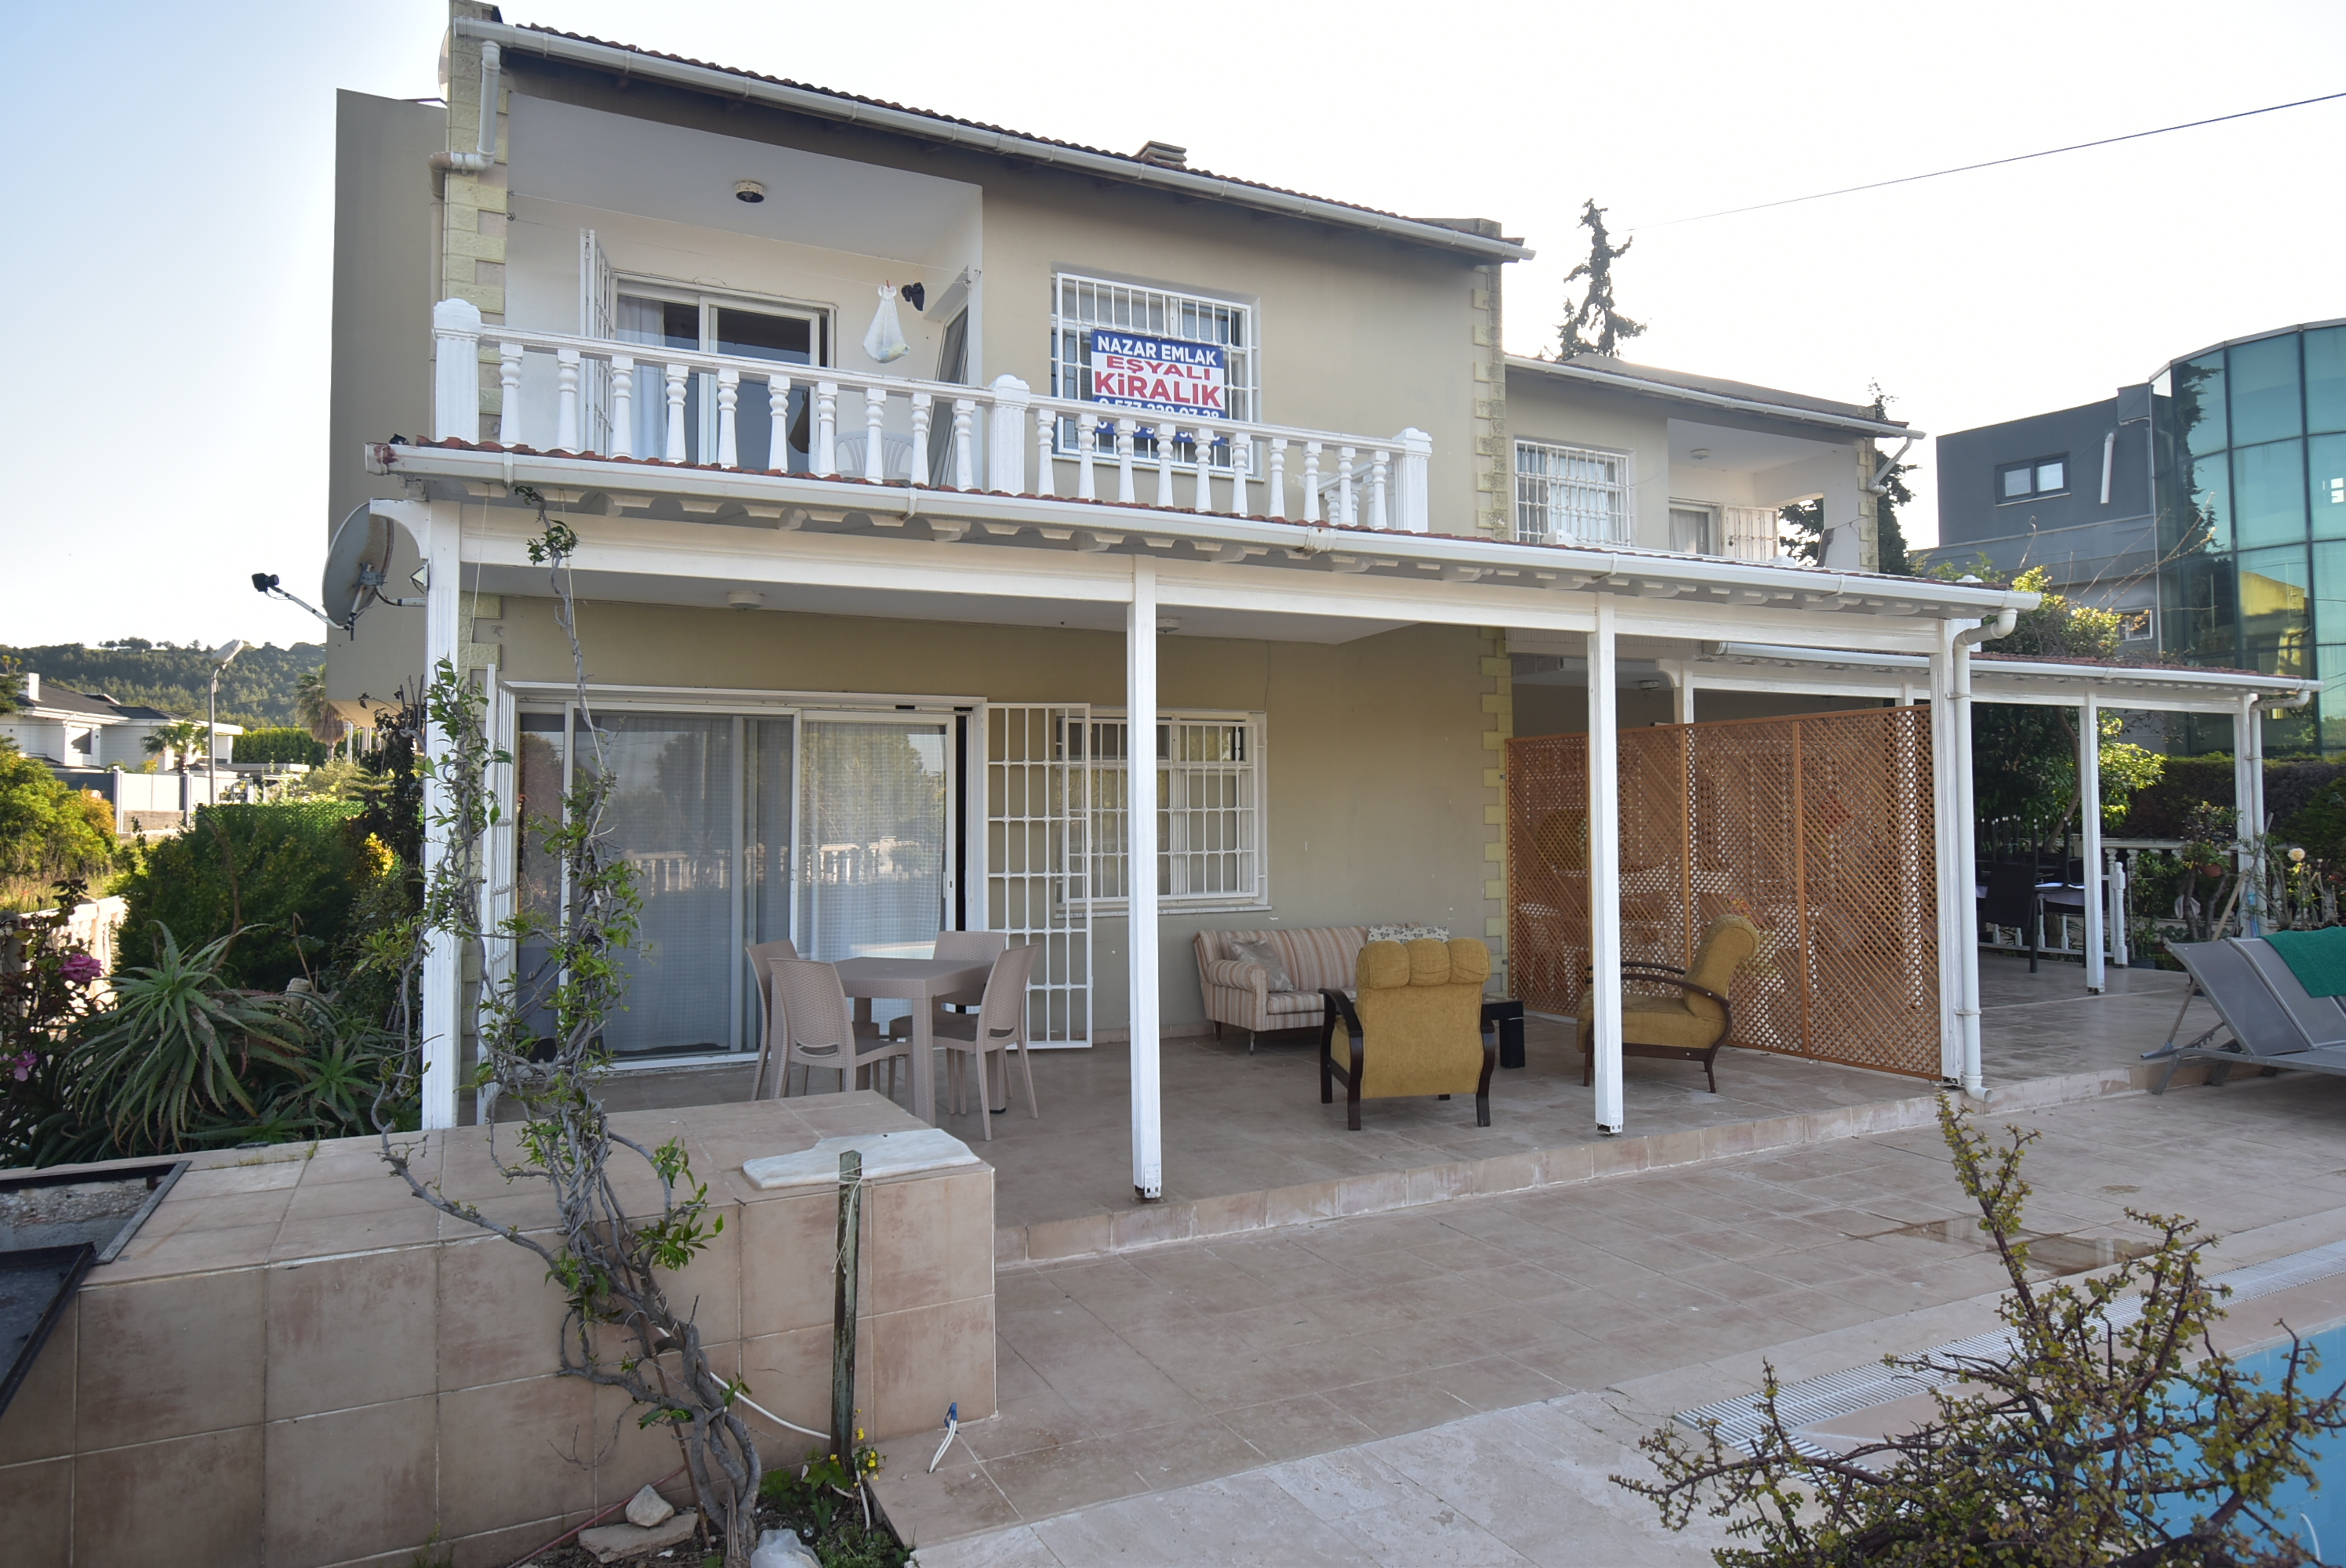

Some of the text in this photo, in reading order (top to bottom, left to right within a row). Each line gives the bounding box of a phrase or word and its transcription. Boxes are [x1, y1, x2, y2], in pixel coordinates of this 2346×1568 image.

[1098, 335, 1218, 367] NAZAR EMLAK
[1106, 354, 1211, 381] EŞYALI
